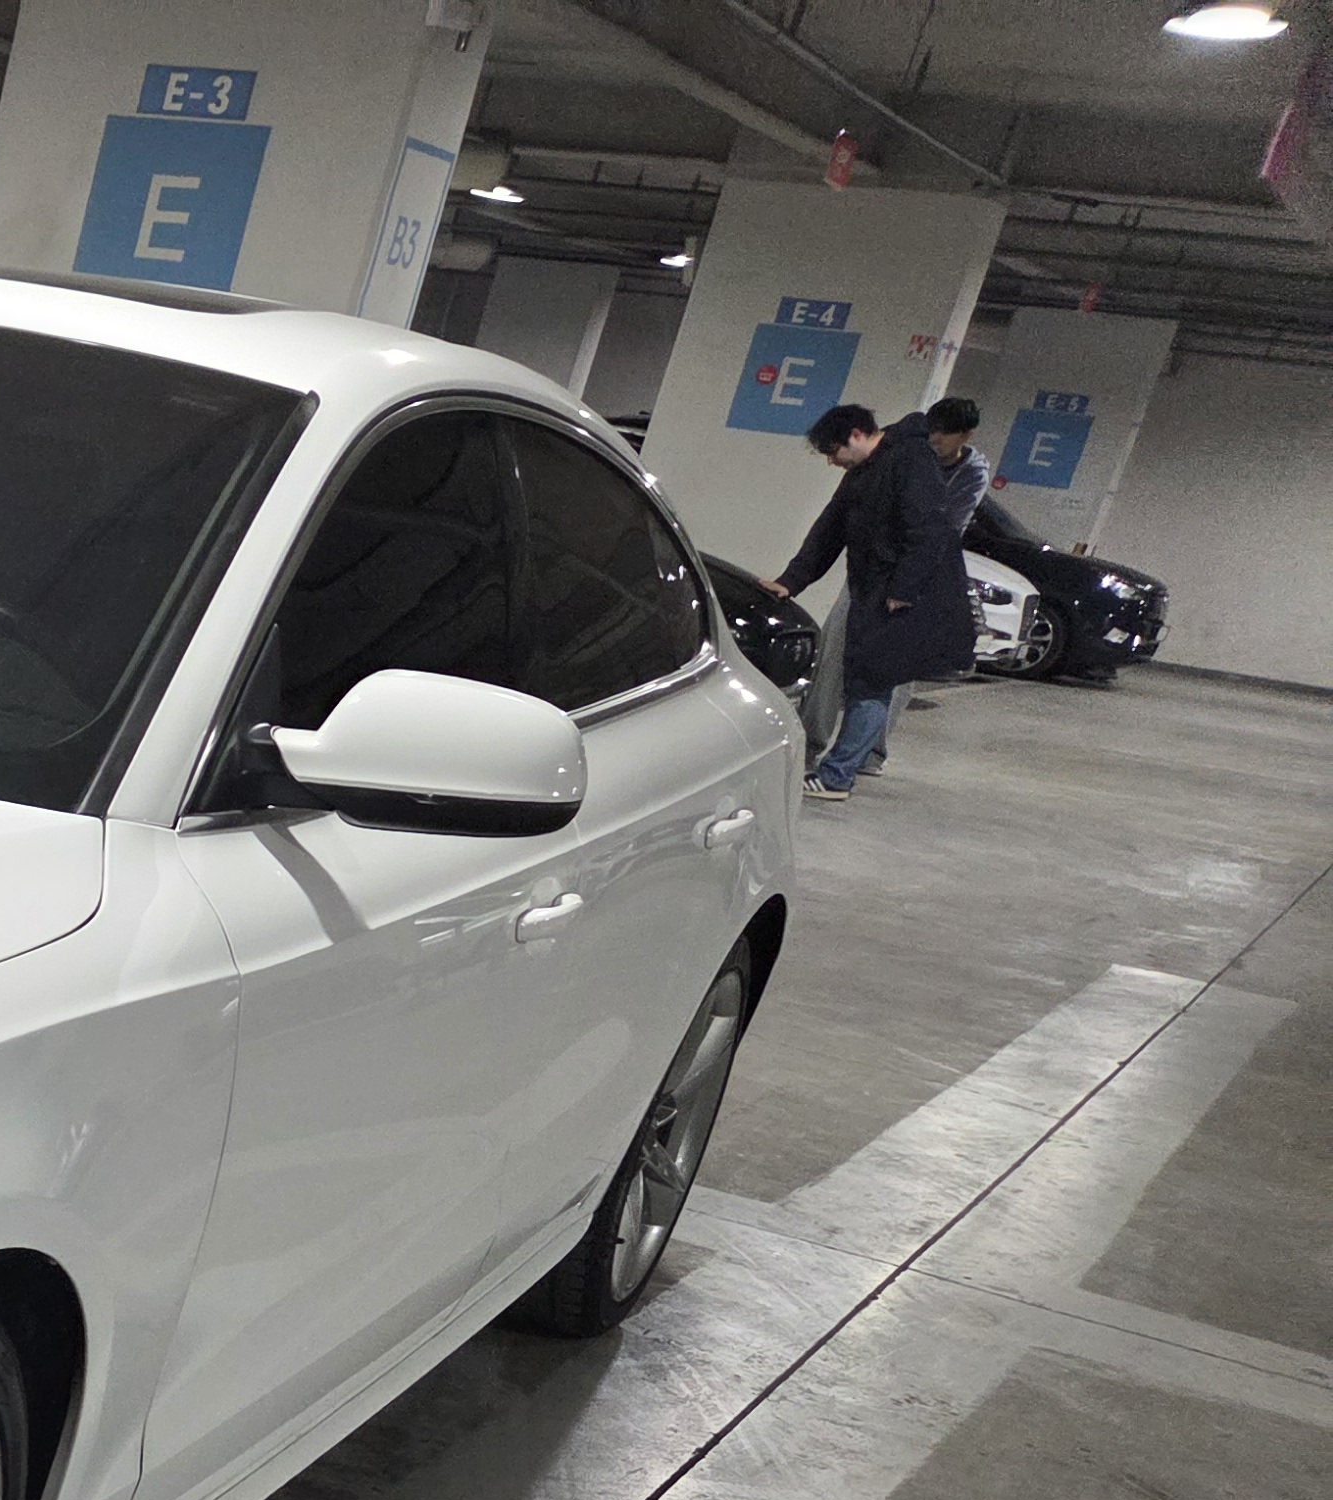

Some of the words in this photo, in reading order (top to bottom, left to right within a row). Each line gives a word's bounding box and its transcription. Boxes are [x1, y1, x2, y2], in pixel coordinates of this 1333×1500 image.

[162, 72, 232, 115] E-3
[134, 174, 201, 262] E
[387, 215, 421, 269] B3
[791, 301, 836, 326] E-4
[770, 356, 815, 406] E
[1027, 431, 1061, 467] E
